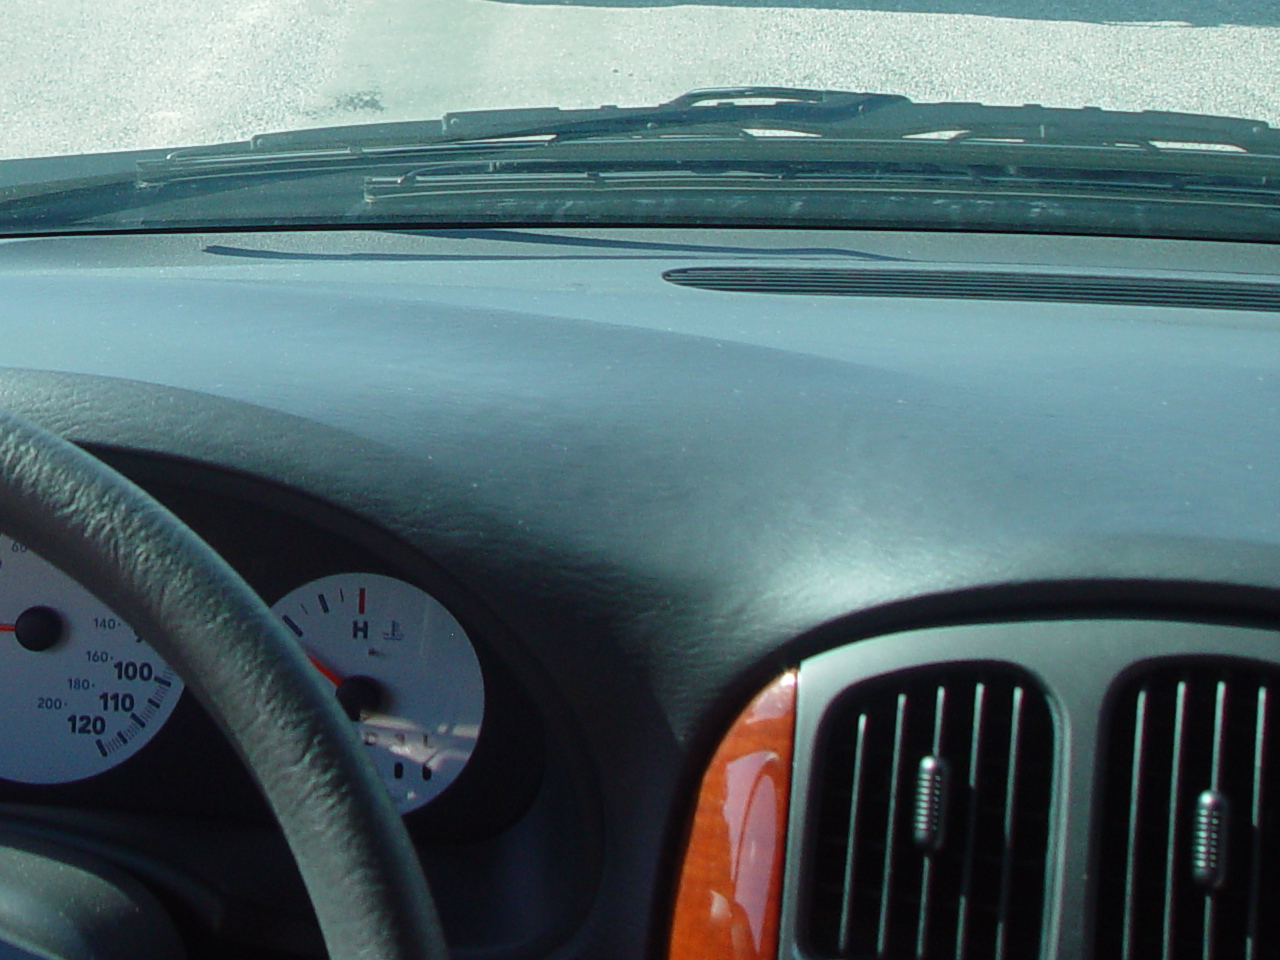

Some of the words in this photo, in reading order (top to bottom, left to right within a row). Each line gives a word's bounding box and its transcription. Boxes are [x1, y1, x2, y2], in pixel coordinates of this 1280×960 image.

[94, 617, 116, 630] 140
[352, 620, 369, 639] H
[86, 650, 109, 663] 160
[114, 661, 153, 682] 100
[69, 678, 90, 691] 180
[37, 697, 62, 710] 200
[99, 693, 135, 713] 110
[67, 716, 106, 735] 120
